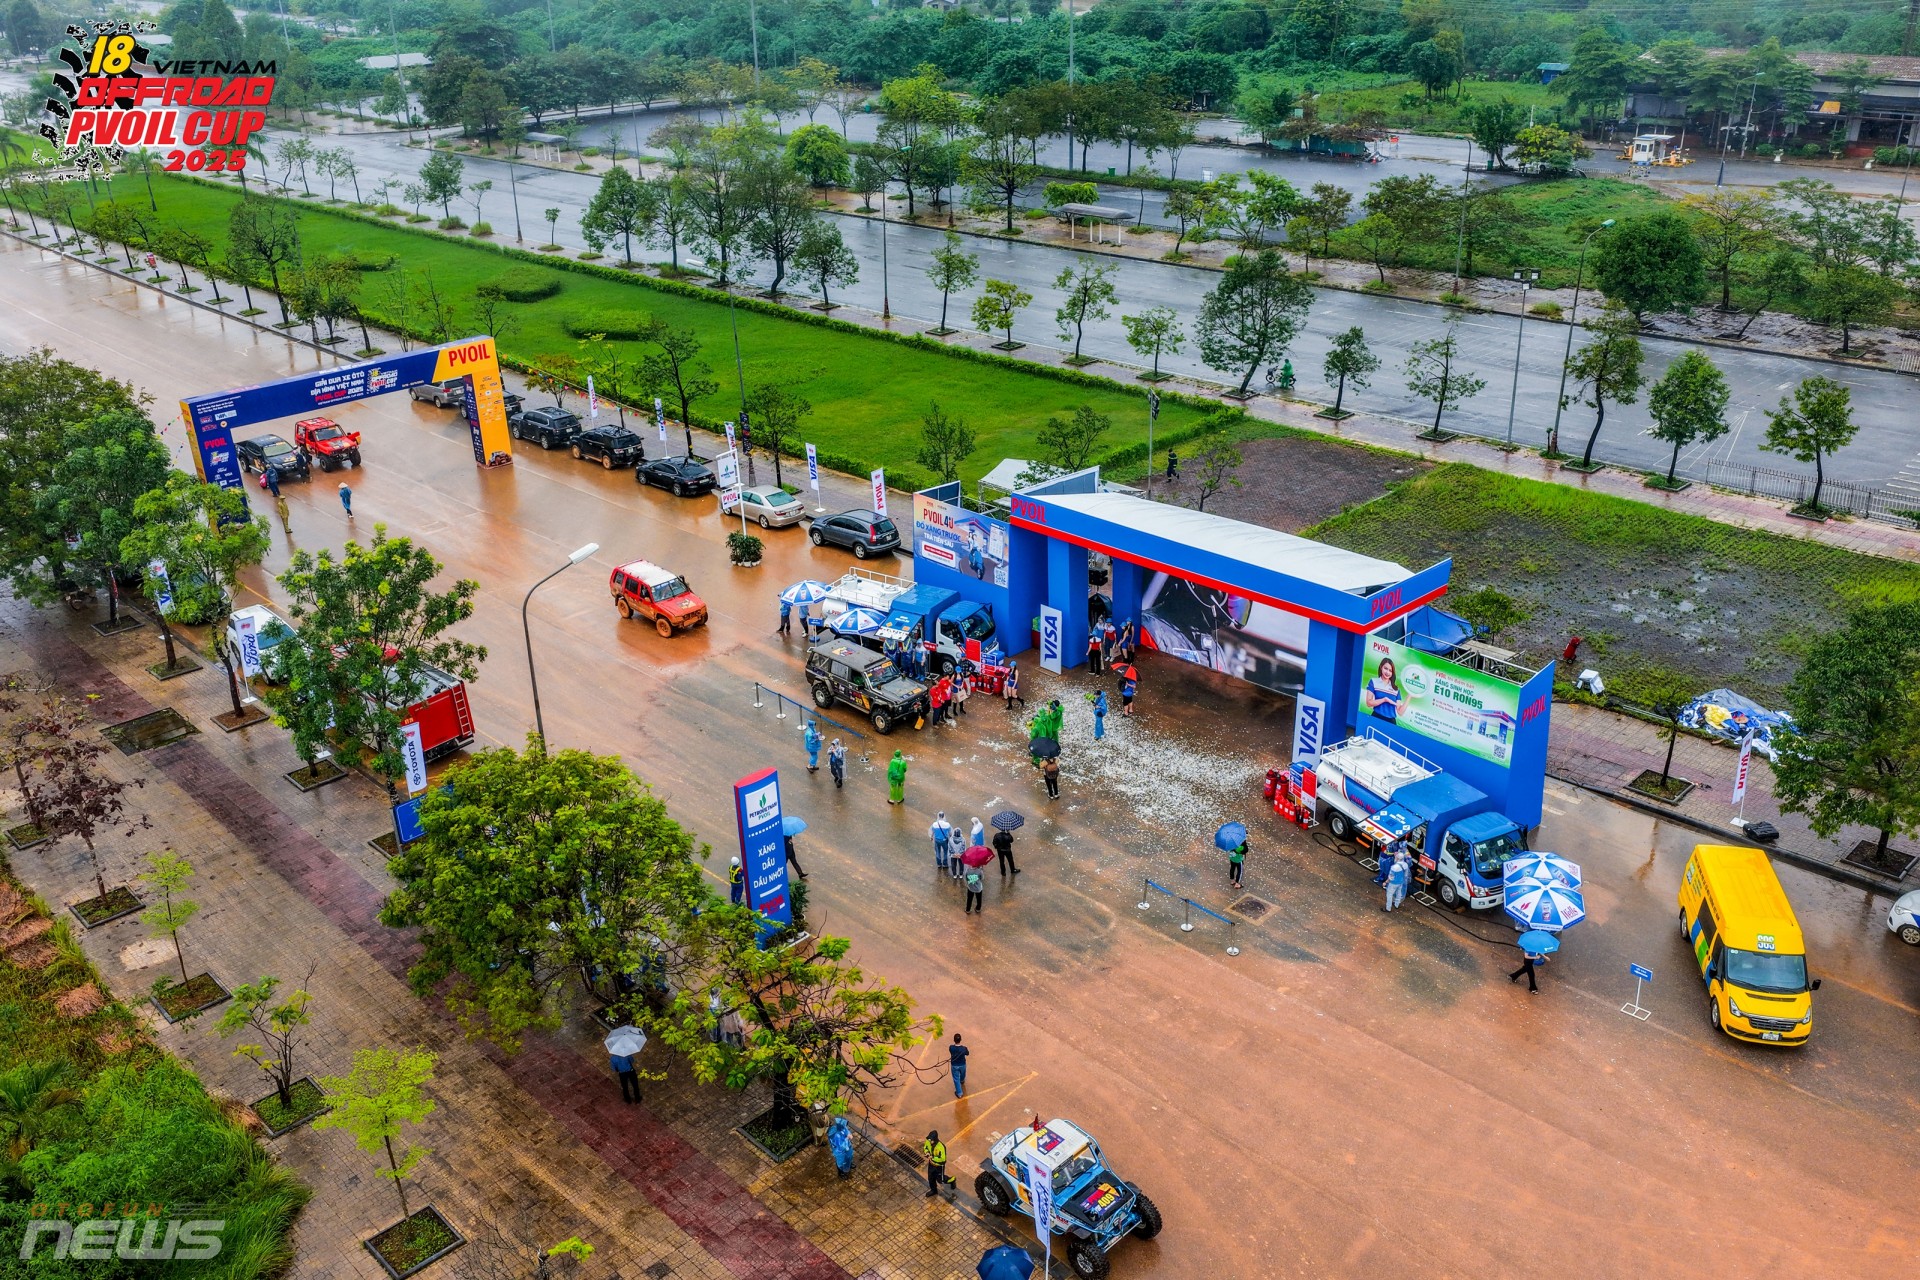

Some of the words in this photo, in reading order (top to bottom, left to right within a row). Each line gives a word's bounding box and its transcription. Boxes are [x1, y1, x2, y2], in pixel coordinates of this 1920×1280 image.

[448, 343, 491, 367] PVOIL
[342, 374, 351, 382] XE
[334, 389, 347, 398] CUP
[204, 437, 227, 450] PVOIL
[808, 455, 817, 480] VISA
[722, 491, 738, 502] PVOIL
[875, 482, 885, 511] PVOIL
[923, 508, 944, 527] PVOIL
[1010, 497, 1047, 523] PVOIL
[1371, 587, 1403, 619] PVOIL
[242, 632, 260, 667] Ford
[1044, 615, 1058, 662] VISA
[1373, 642, 1390, 655] PVOIL
[1434, 684, 1451, 698] E10
[1453, 690, 1484, 710] RON95
[1450, 683, 1463, 693] SINH
[1521, 694, 1547, 729] PVOIL
[1298, 704, 1320, 757] VISA
[407, 739, 419, 775] TOYOTA
[748, 801, 778, 819] PETROVIETNAM
[758, 841, 776, 858] XĂNG
[1097, 1193, 1115, 1208] 409
